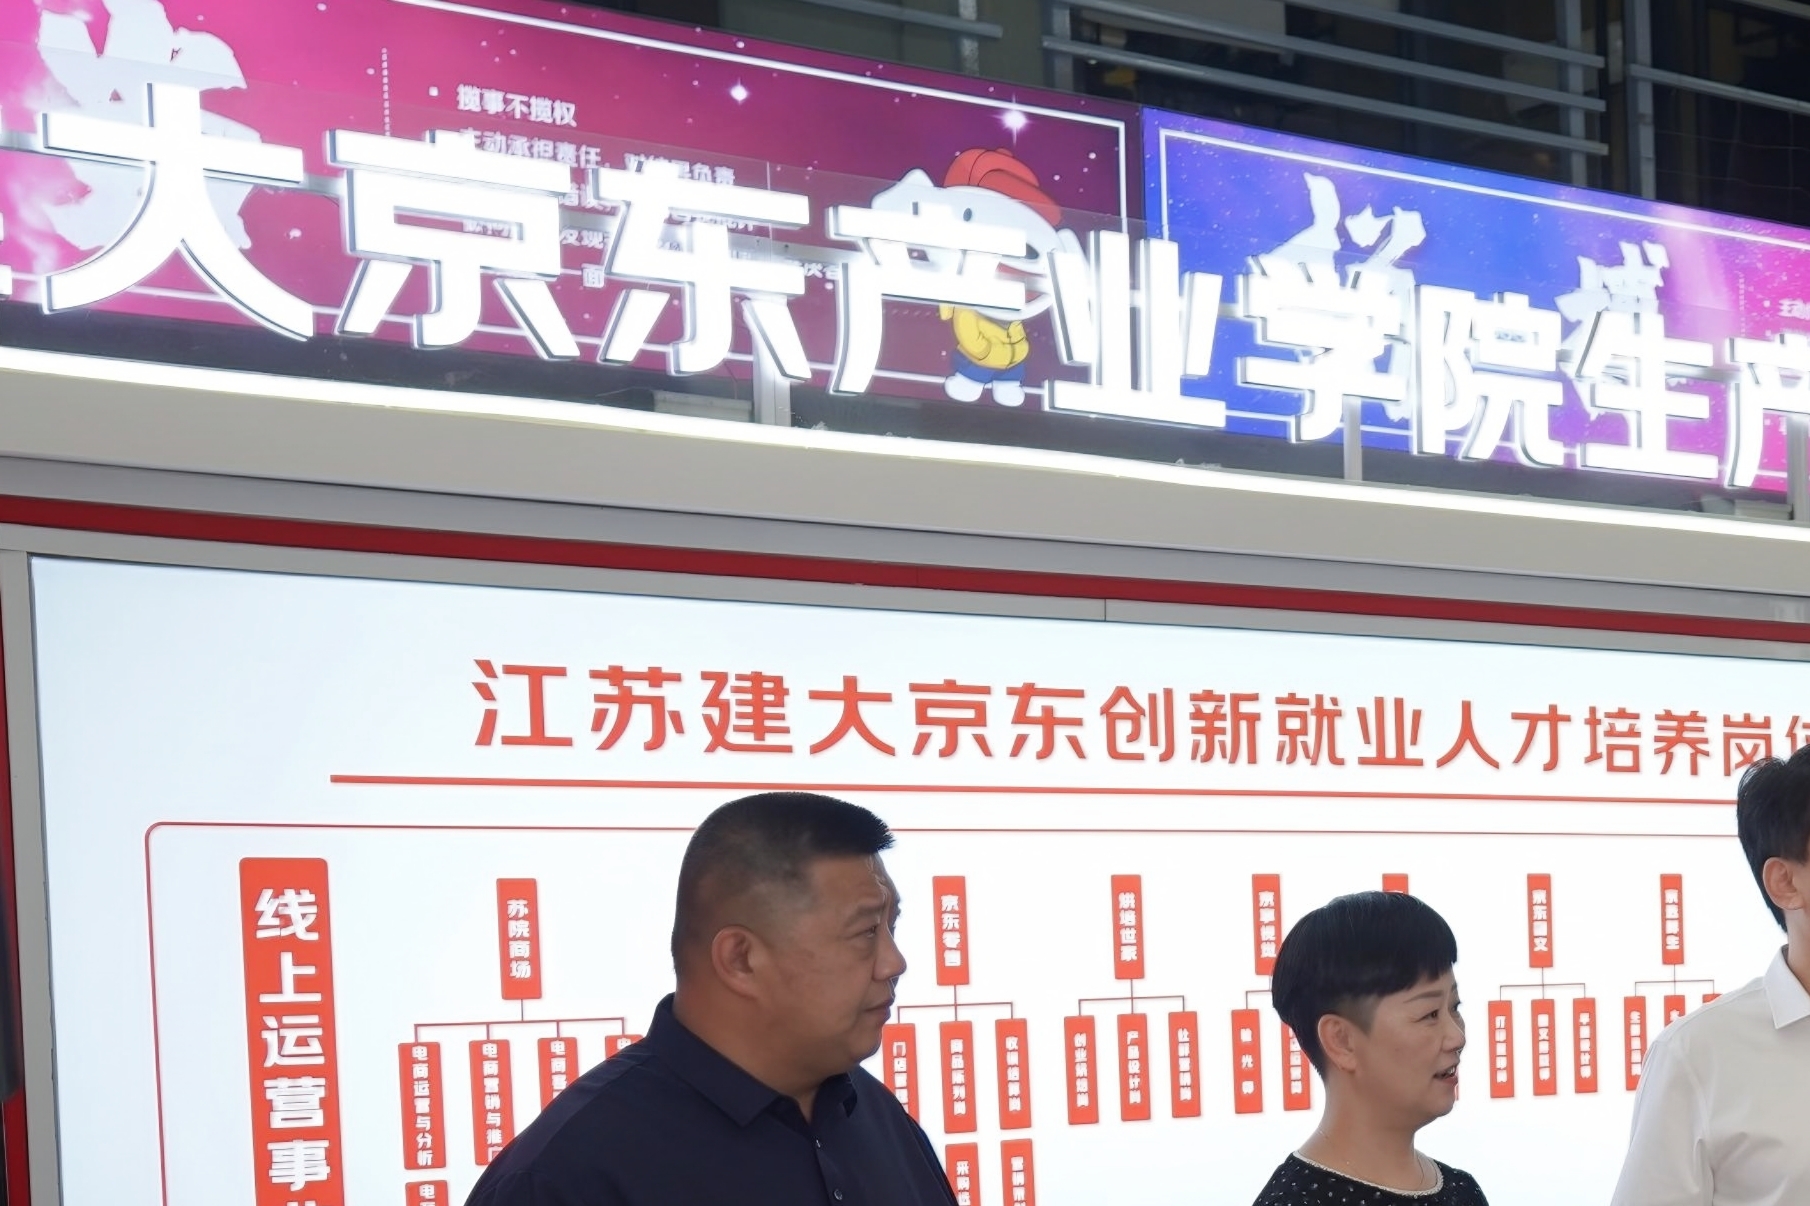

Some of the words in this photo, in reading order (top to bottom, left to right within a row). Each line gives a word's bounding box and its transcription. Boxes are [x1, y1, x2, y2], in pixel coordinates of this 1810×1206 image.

[456, 83, 578, 127] 揽事不揽权
[506, 898, 533, 979] 苏院商场
[411, 1044, 433, 1167] 电商运营与分析
